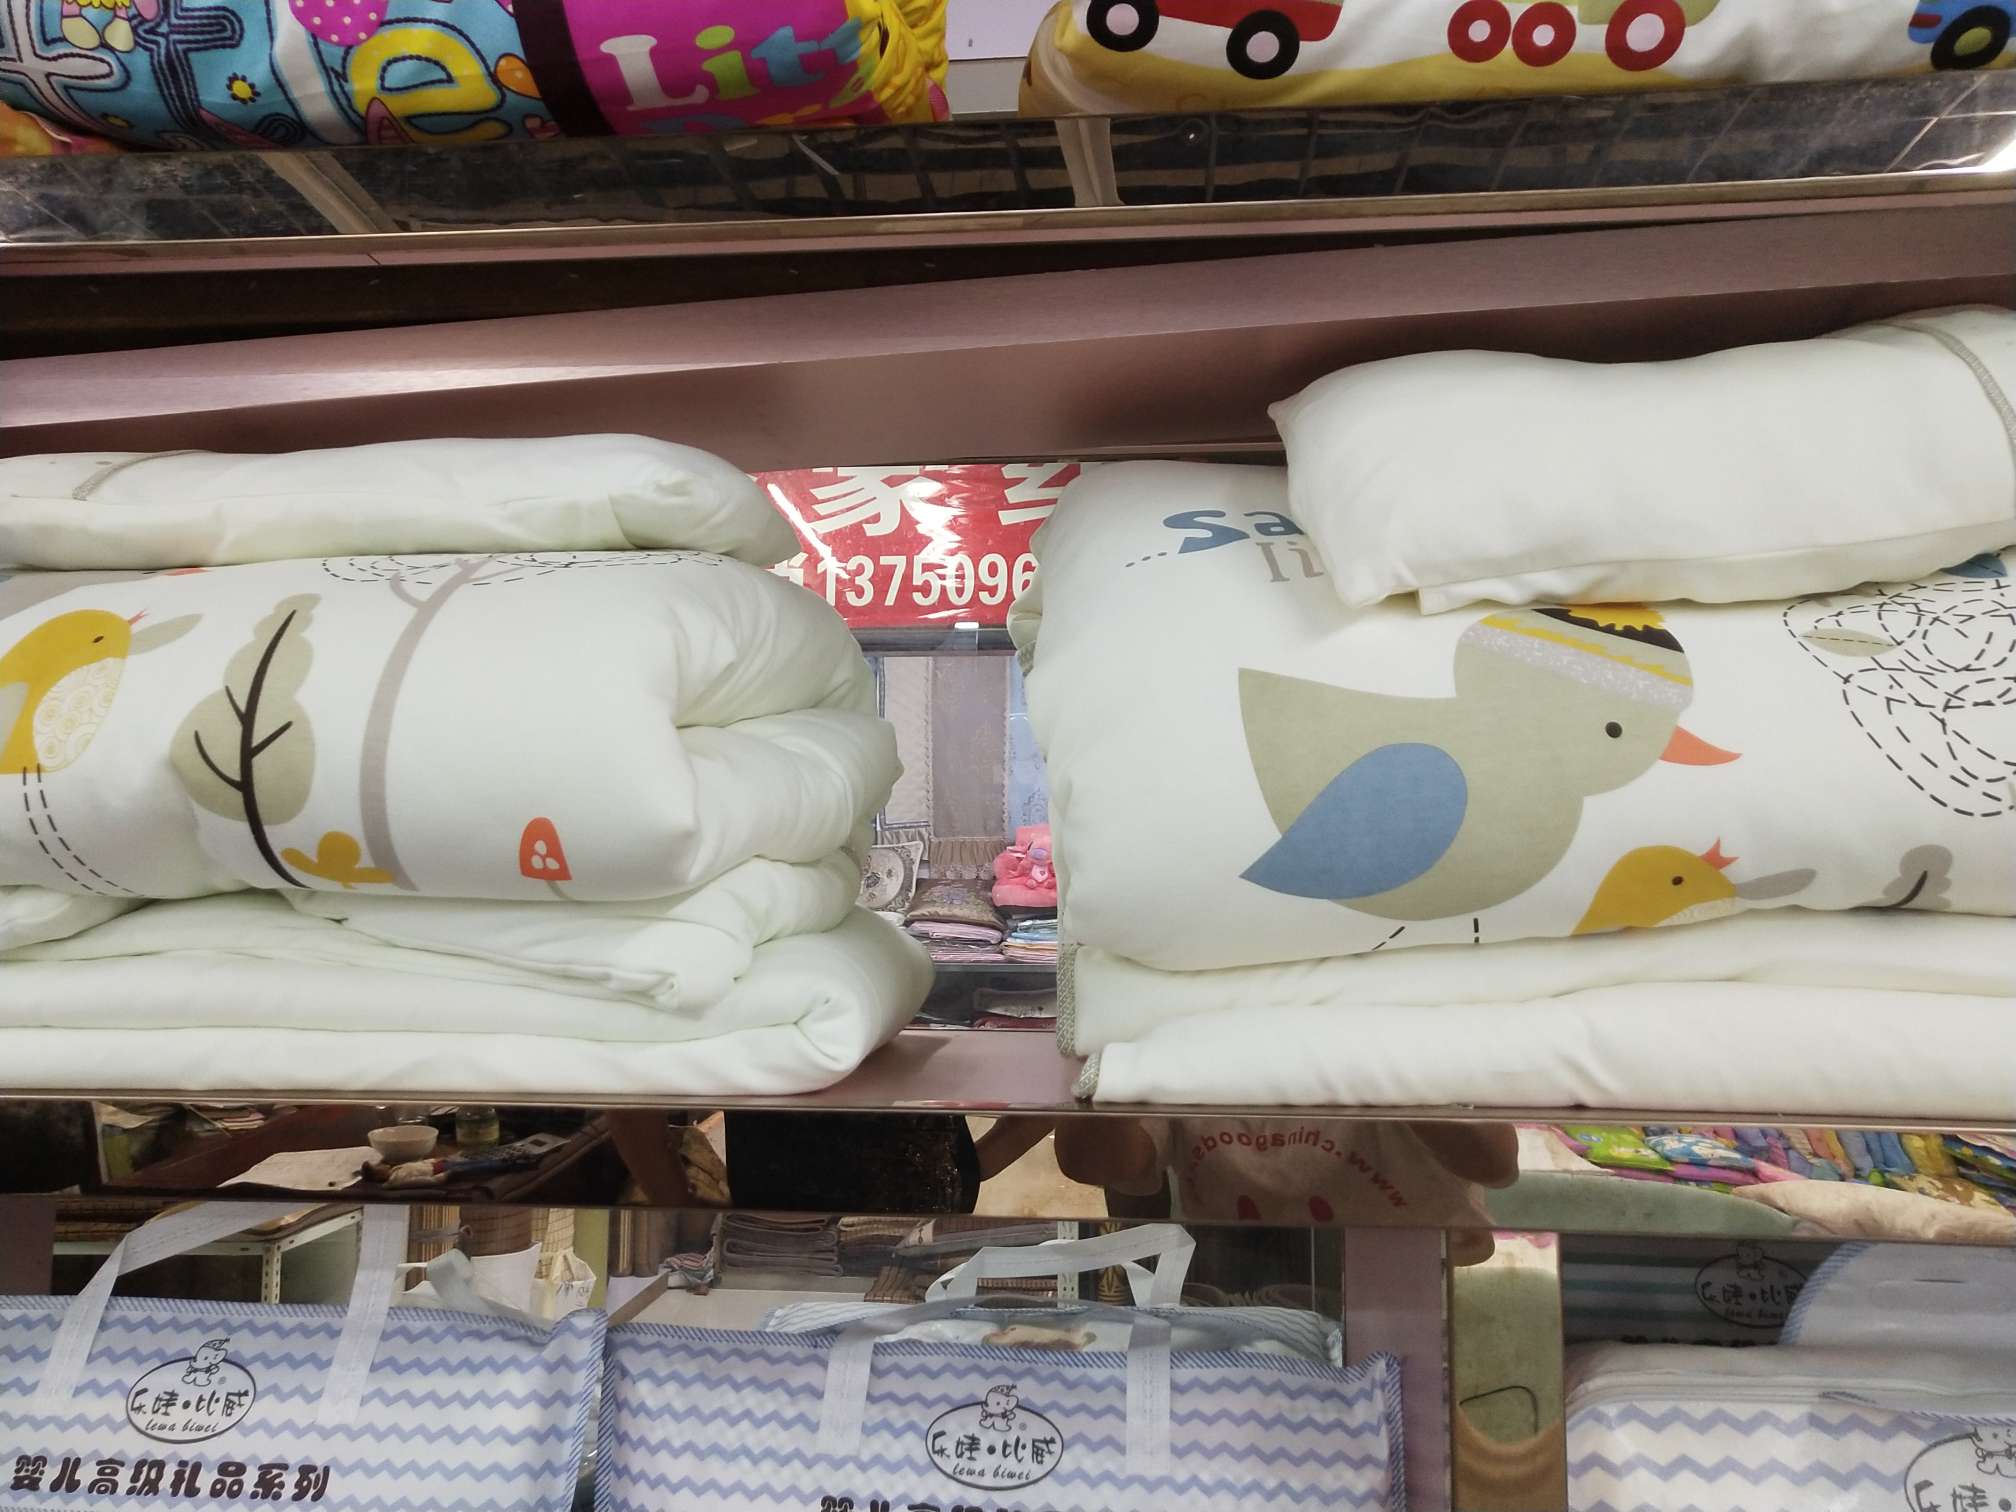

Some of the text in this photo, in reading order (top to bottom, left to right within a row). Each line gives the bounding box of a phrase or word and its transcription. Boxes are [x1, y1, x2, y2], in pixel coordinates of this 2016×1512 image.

[144, 1418, 220, 1434] lewa biwei
[9, 1454, 331, 1503] 婴儿高级礼品系列
[952, 1463, 1032, 1480] lewa biwei
